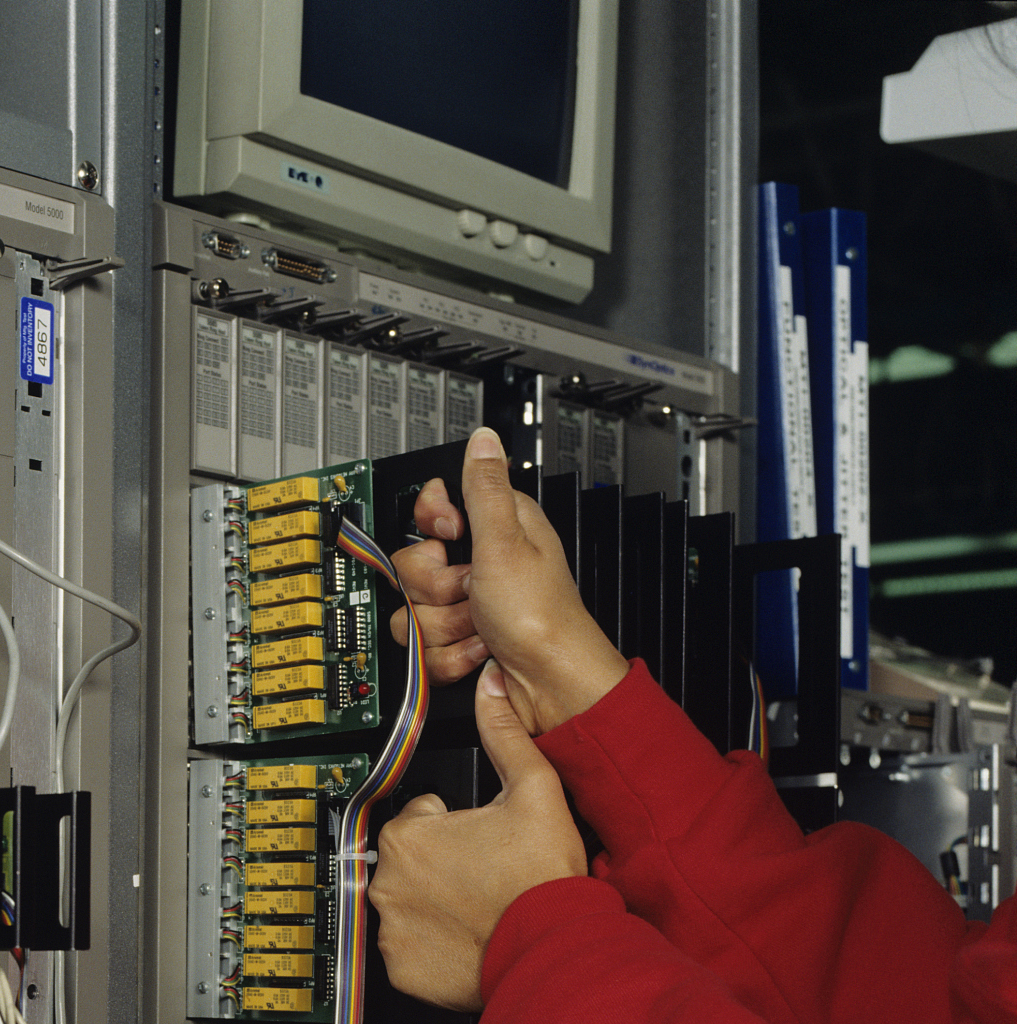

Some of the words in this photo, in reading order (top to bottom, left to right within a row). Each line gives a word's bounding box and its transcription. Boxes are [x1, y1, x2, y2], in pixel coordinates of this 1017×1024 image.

[25, 201, 46, 215] Model
[47, 206, 64, 220] 5000
[37, 319, 47, 366] 4867
[27, 365, 32, 376] DO
